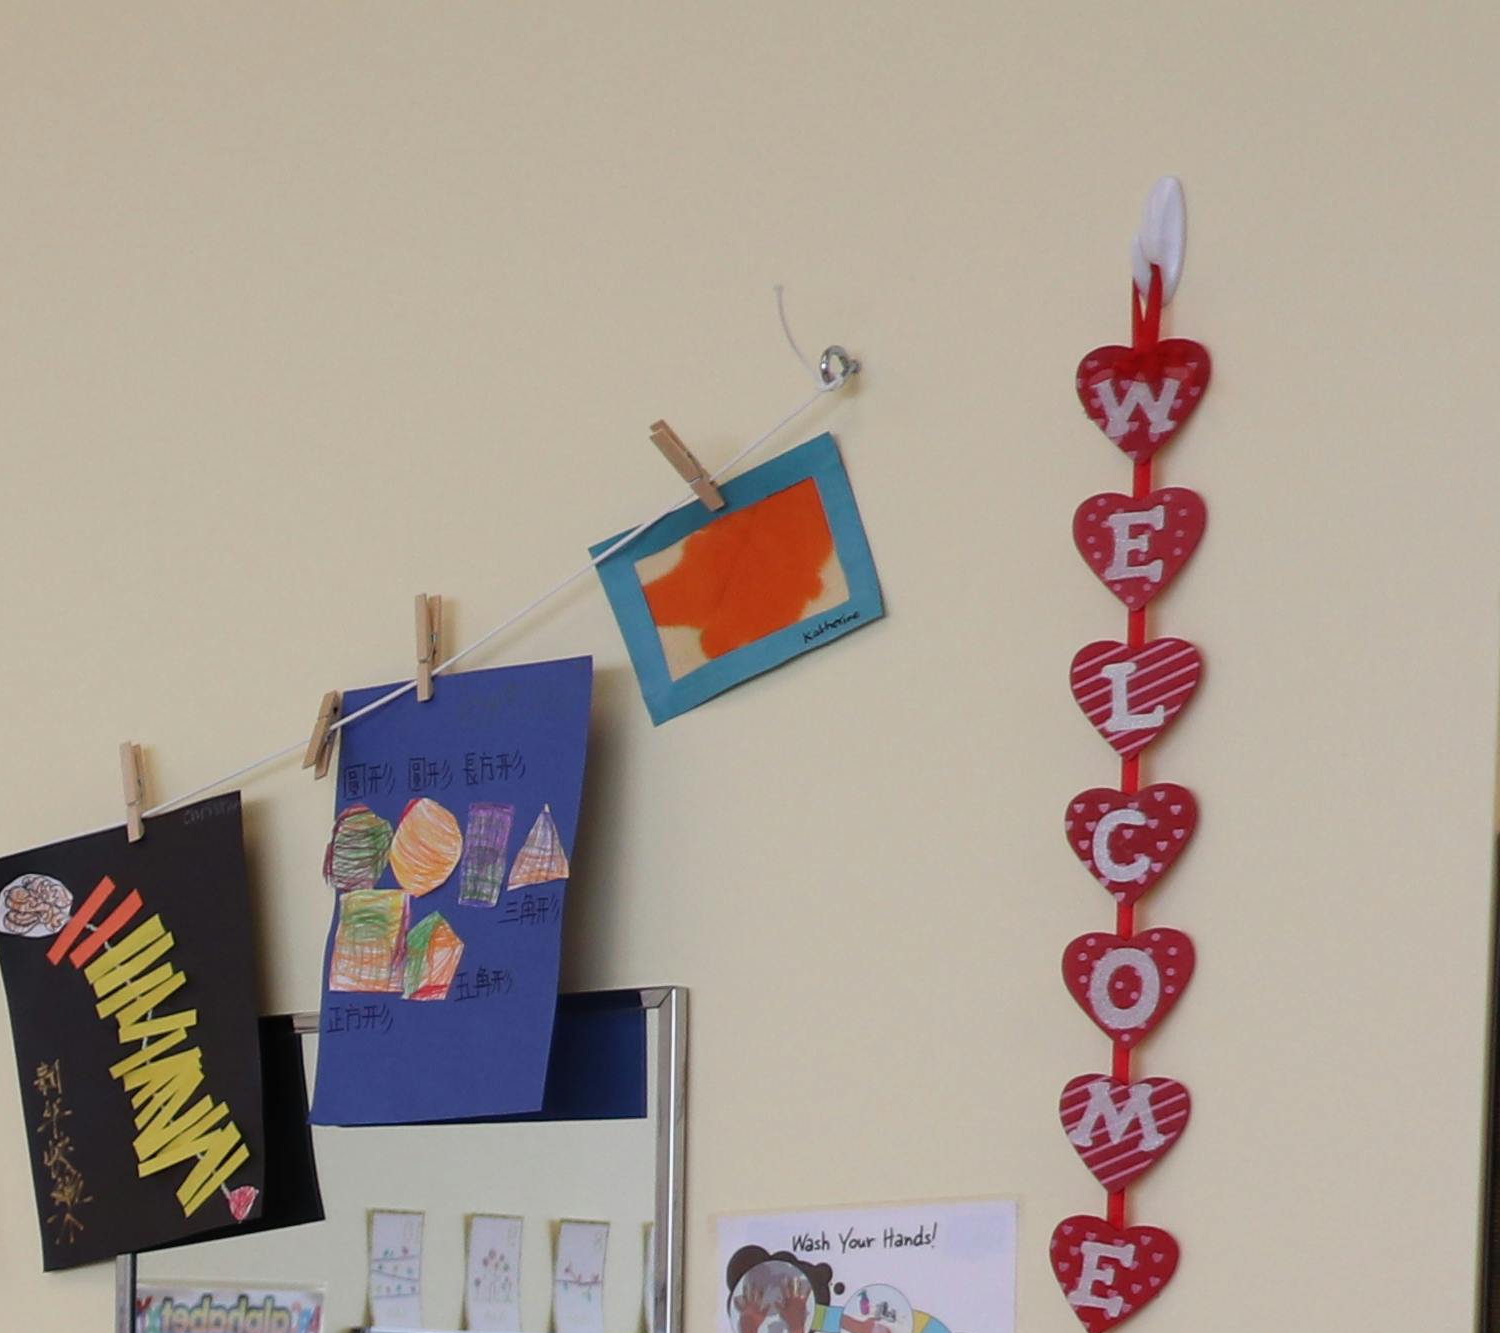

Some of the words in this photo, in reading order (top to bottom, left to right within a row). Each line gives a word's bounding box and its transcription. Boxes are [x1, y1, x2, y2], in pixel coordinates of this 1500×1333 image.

[802, 610, 861, 645] Katherine
[1067, 376, 1179, 1318] WELCOME
[326, 1003, 395, 1035] 正方形
[791, 1232, 832, 1254] Wash
[838, 1226, 876, 1254] Your
[883, 1221, 939, 1250] Hands!
